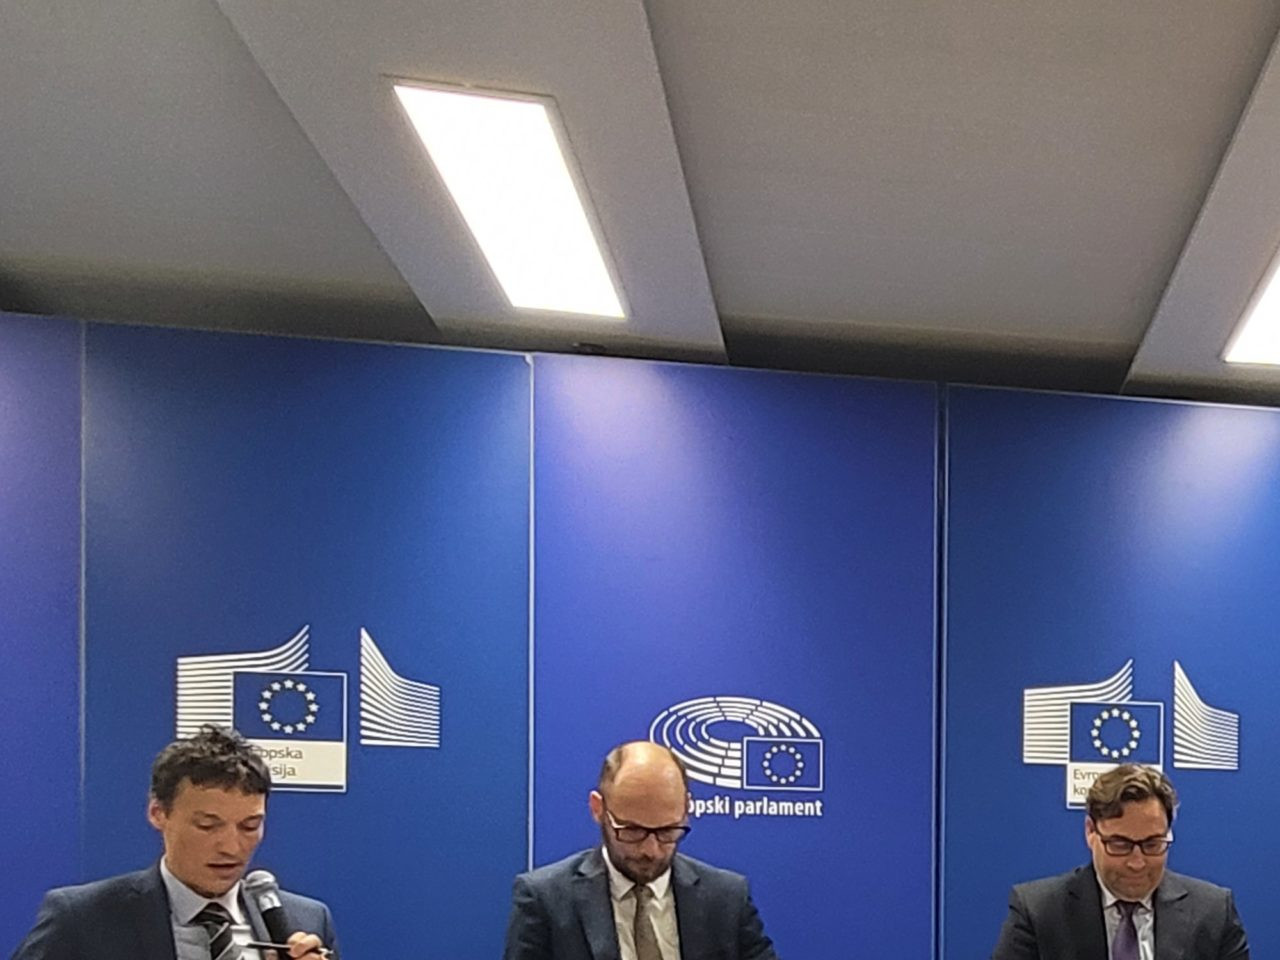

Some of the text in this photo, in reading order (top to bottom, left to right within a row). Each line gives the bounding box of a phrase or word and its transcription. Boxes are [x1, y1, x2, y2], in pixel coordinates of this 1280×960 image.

[260, 746, 303, 760] opska
[271, 763, 296, 779] sija
[1073, 768, 1098, 780] Evro
[687, 795, 823, 819] opski parlament
